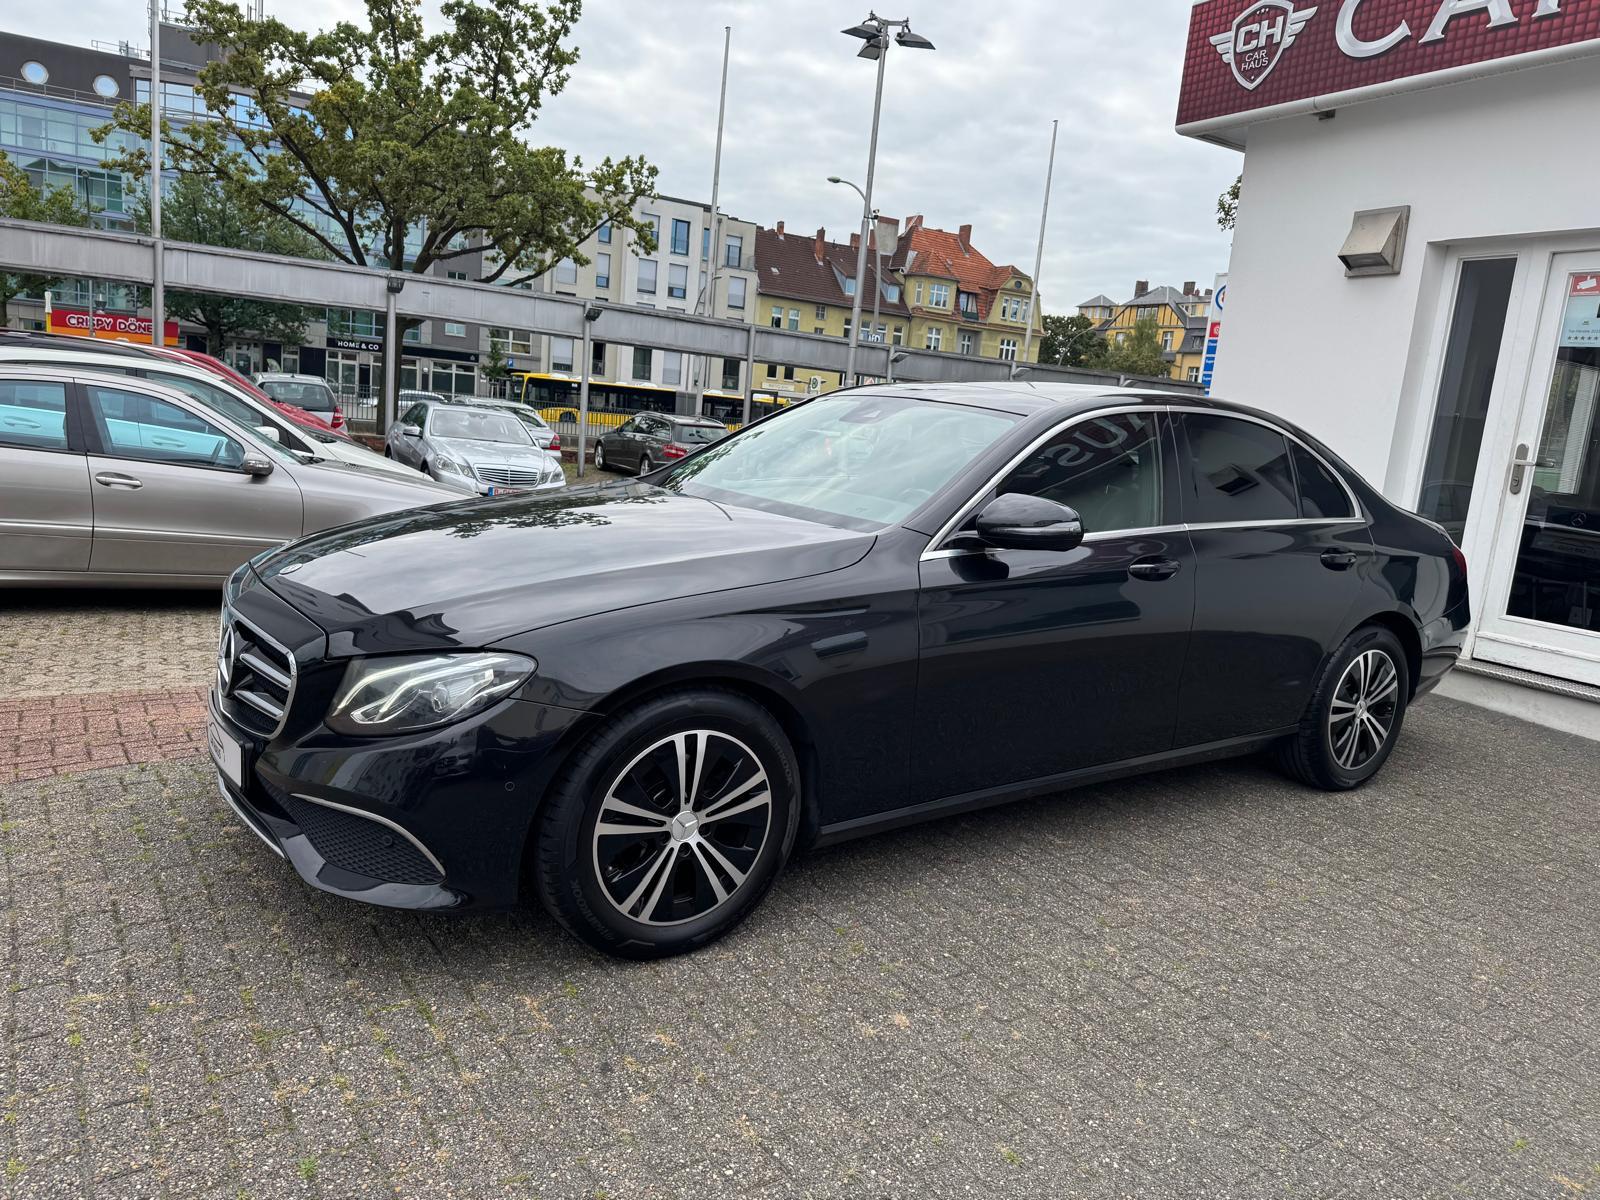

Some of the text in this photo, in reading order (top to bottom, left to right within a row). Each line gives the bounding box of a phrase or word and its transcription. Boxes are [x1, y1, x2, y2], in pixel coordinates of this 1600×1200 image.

[1236, 15, 1284, 53] CH
[1245, 49, 1267, 62] CAR
[1241, 57, 1269, 71] HAUS
[66, 314, 153, 333] CRISPY DÖNE
